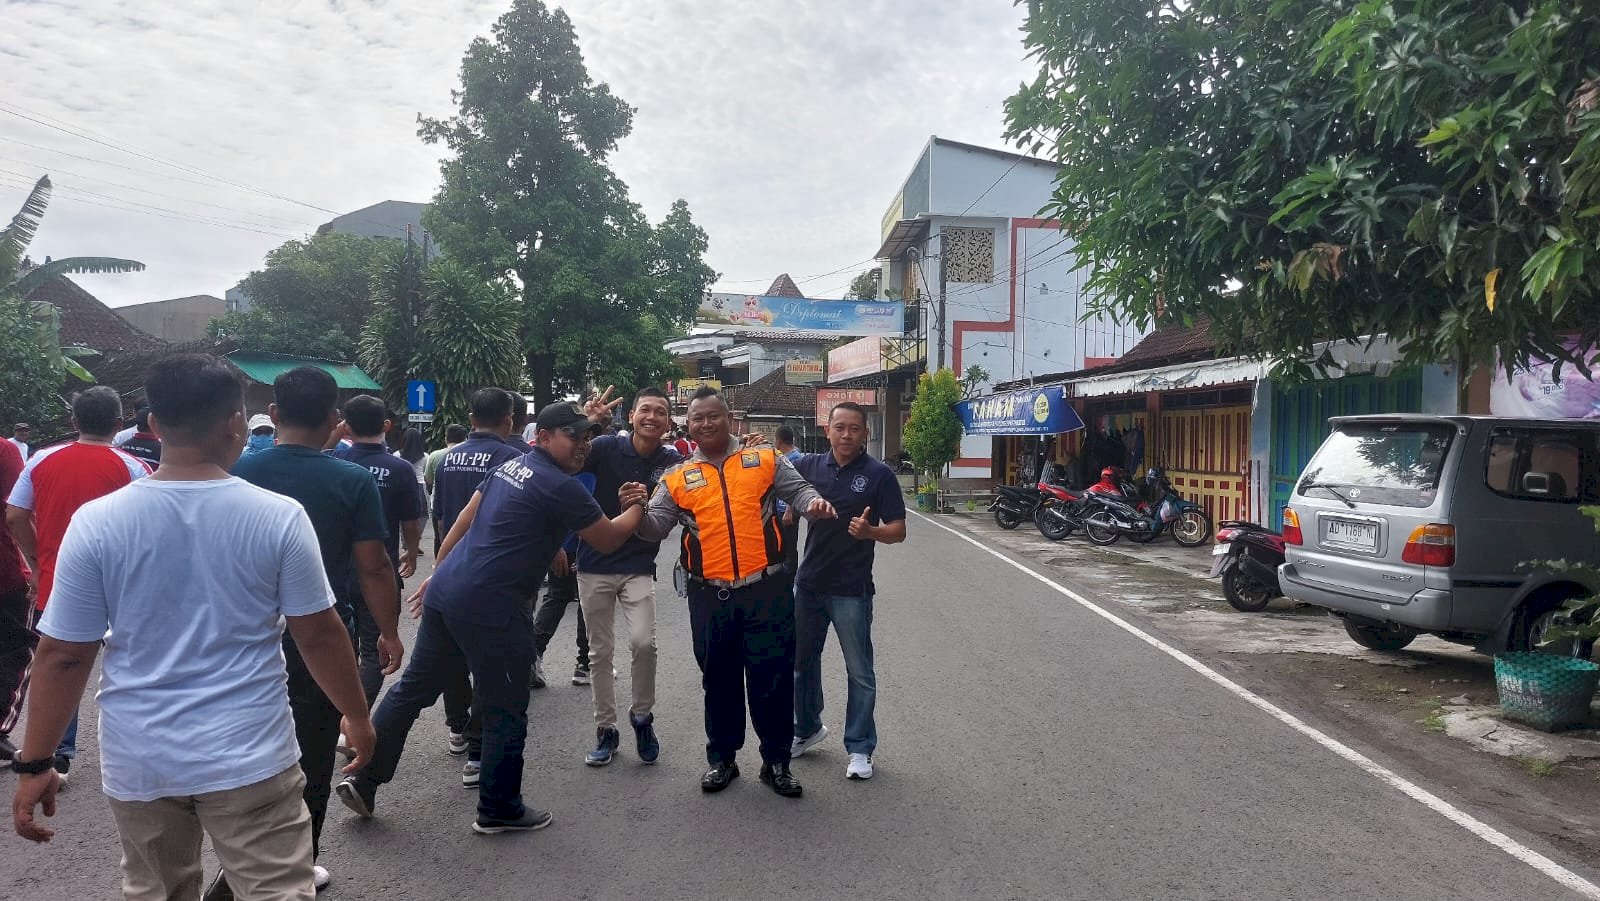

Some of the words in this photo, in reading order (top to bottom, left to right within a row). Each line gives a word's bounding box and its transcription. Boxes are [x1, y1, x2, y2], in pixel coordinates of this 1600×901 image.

[783, 302, 842, 322] Diplomat
[444, 452, 491, 467] POL-PP
[1329, 522, 1340, 534] AD
